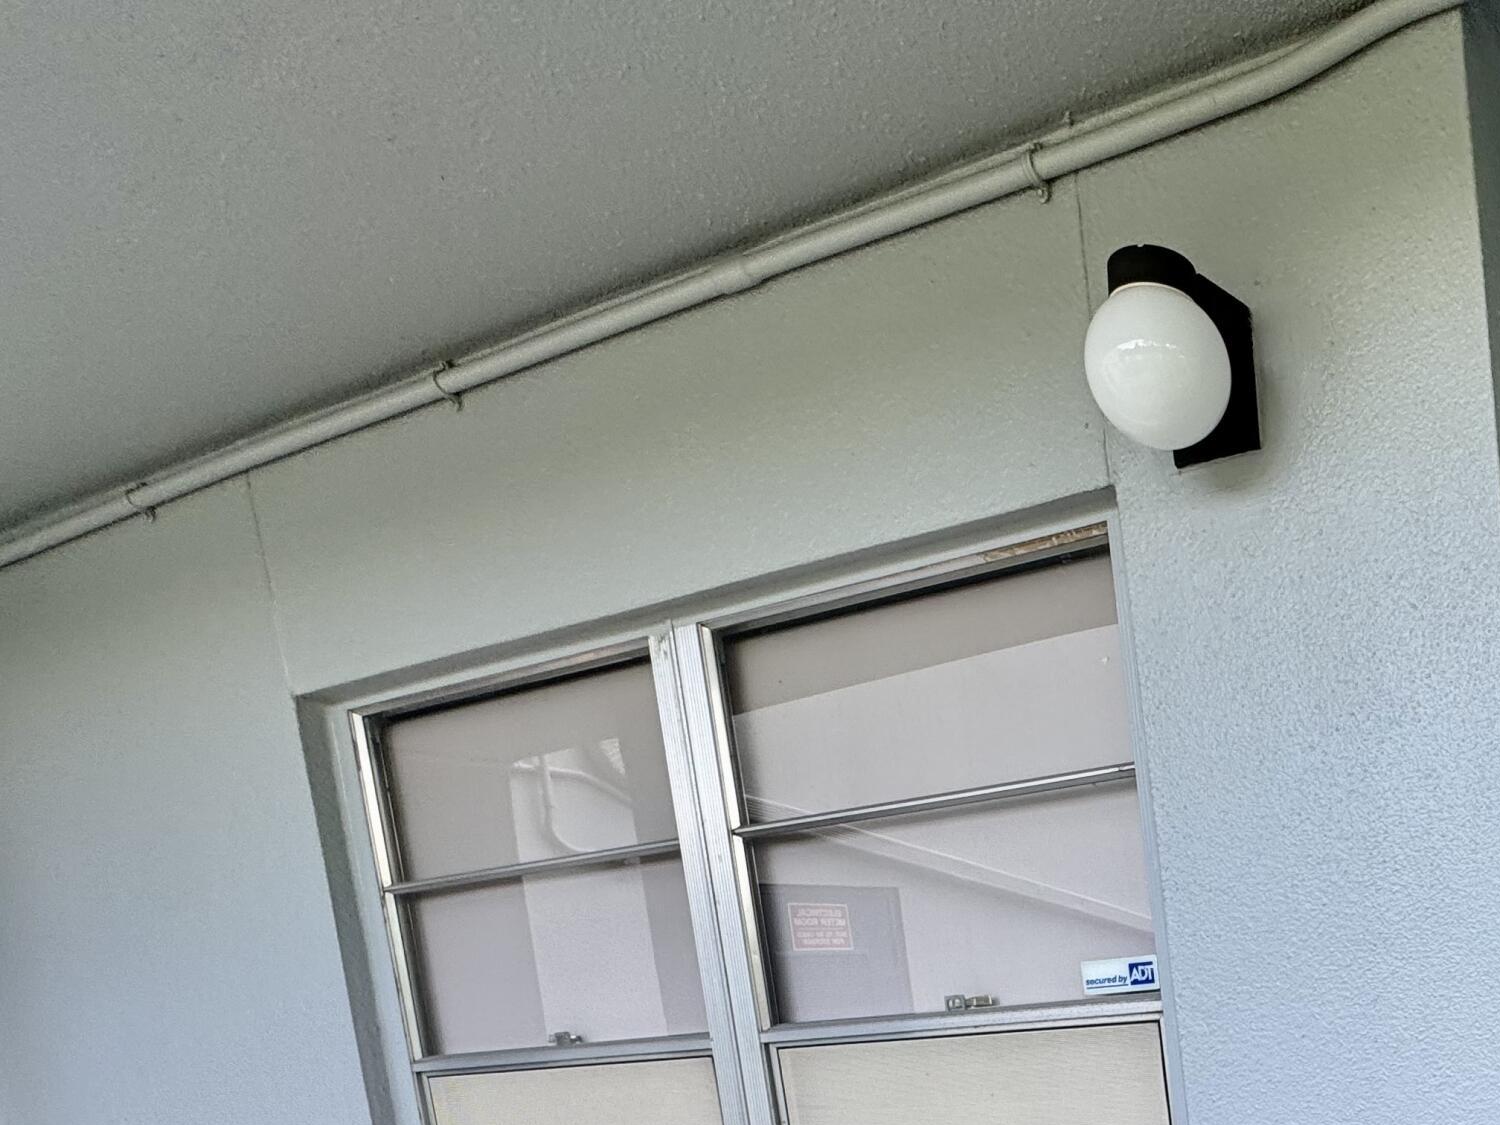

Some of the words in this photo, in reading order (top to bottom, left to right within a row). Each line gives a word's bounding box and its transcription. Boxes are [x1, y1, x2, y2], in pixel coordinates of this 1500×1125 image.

[1086, 976, 1117, 985] secured
[1118, 975, 1128, 984] by
[1129, 965, 1154, 981] ADT
